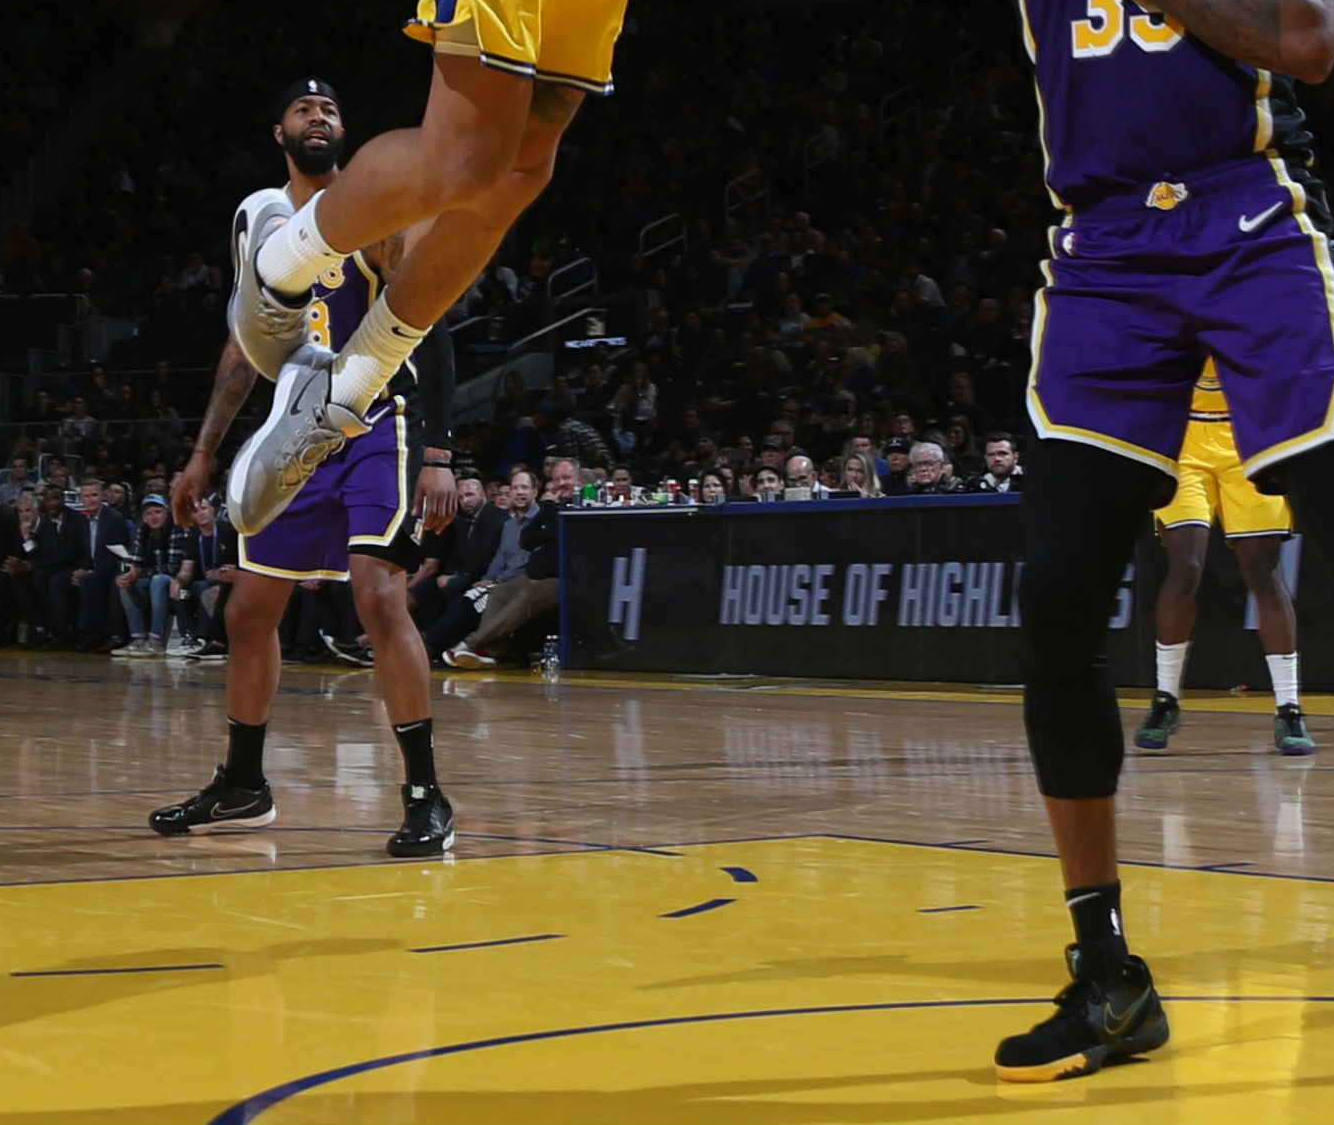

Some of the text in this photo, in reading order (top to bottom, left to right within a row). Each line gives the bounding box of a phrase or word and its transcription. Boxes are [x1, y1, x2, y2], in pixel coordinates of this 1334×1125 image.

[608, 547, 647, 641] H
[720, 564, 836, 626] HOUSE
[843, 563, 893, 626] OF
